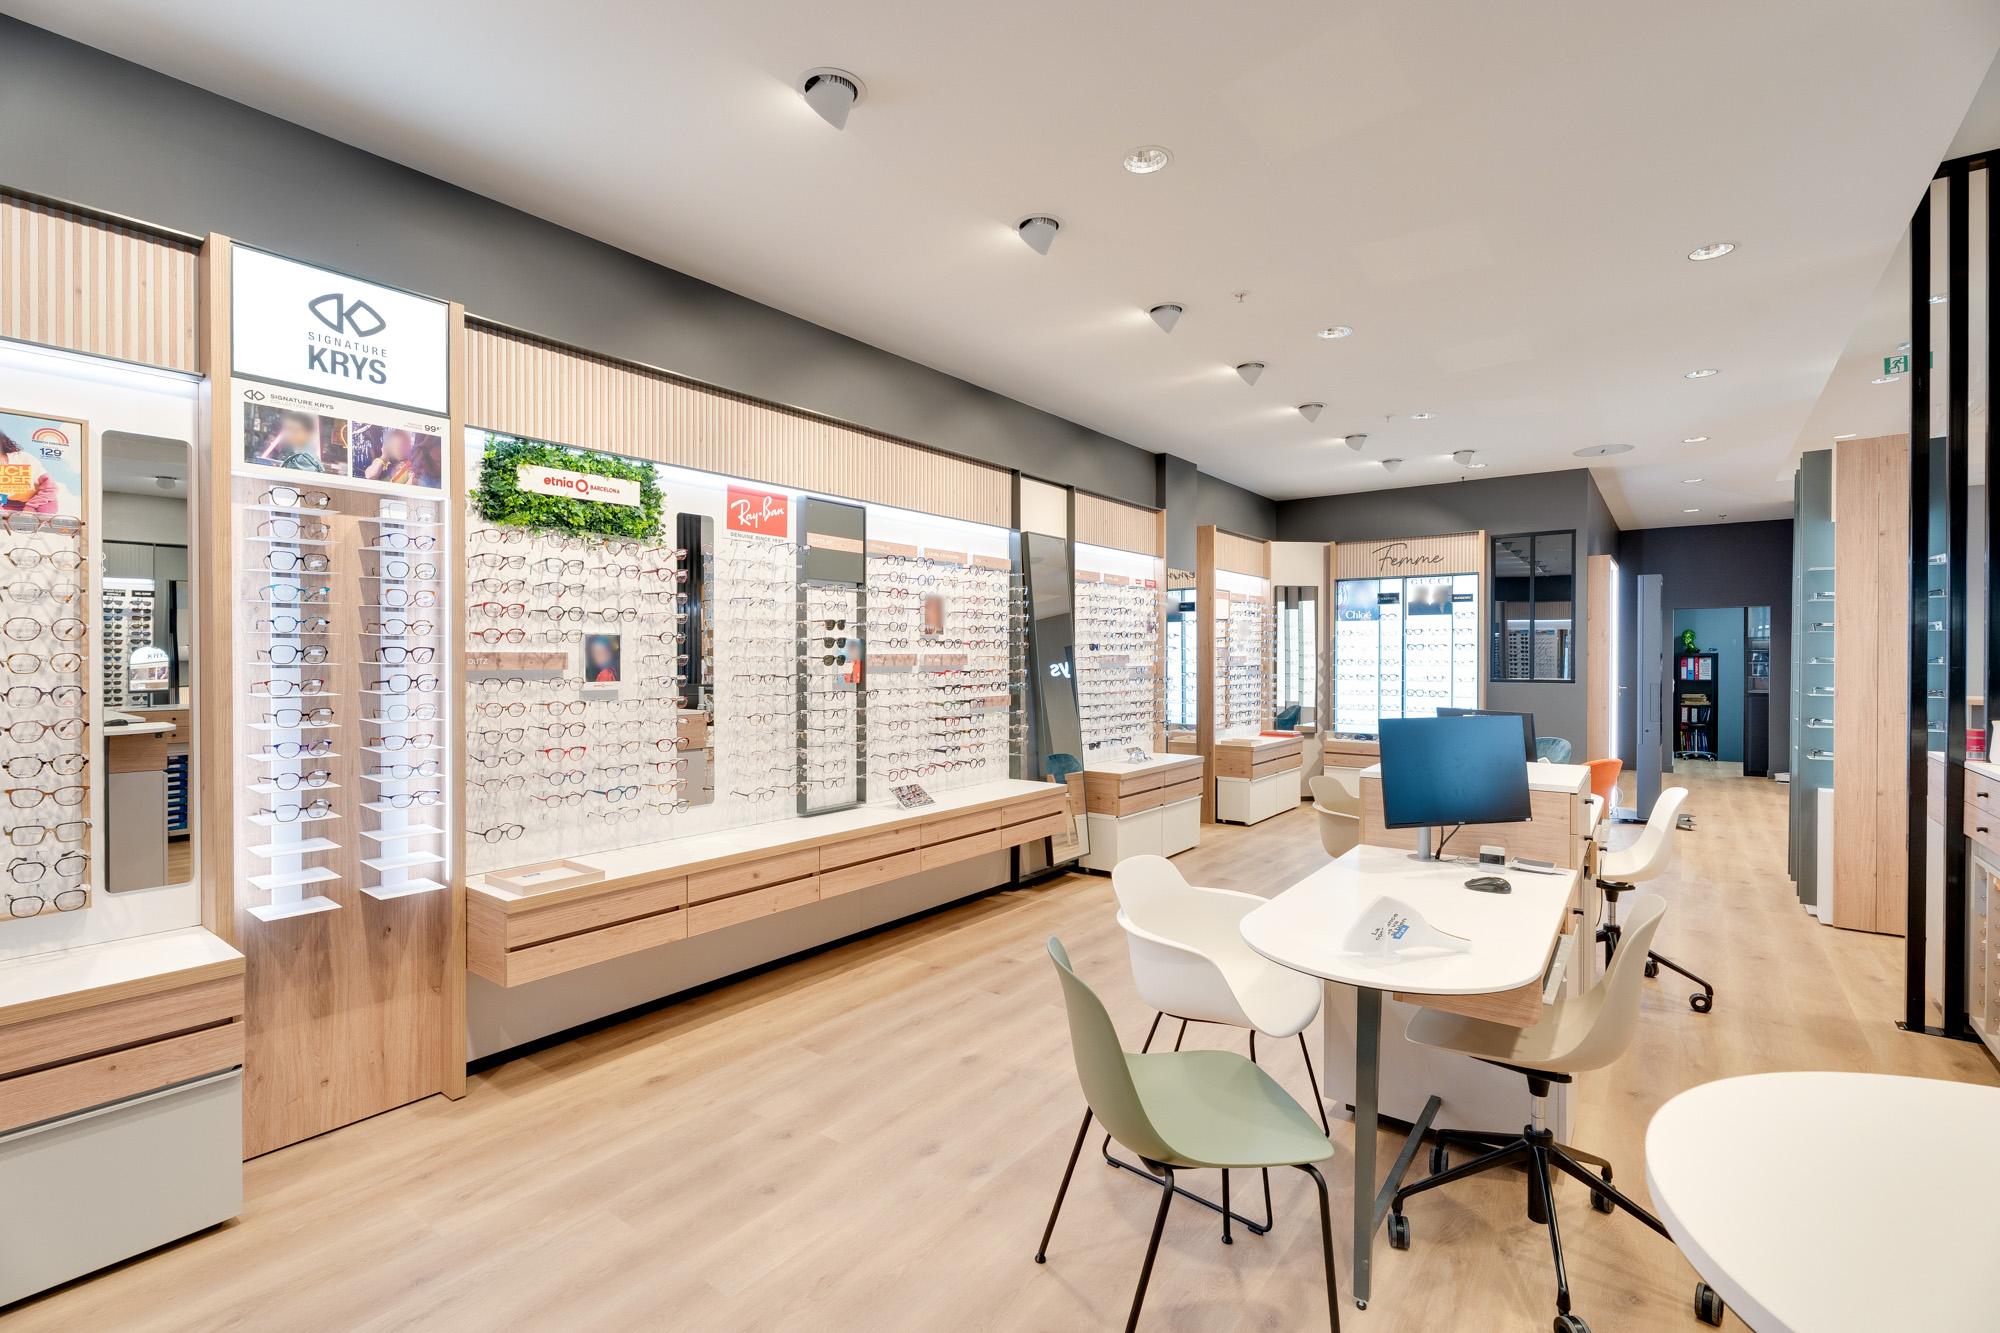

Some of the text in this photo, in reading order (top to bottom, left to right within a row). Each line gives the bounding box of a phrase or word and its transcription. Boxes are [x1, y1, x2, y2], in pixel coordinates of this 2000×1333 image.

[308, 332, 387, 358] SIGNATURE
[308, 344, 386, 385] KRYS
[270, 393, 335, 410] SIGNATURE KRYS
[543, 476, 620, 494] etnia BARCELONA
[1372, 542, 1445, 572] Femme
[1345, 609, 1372, 620] Chloé
